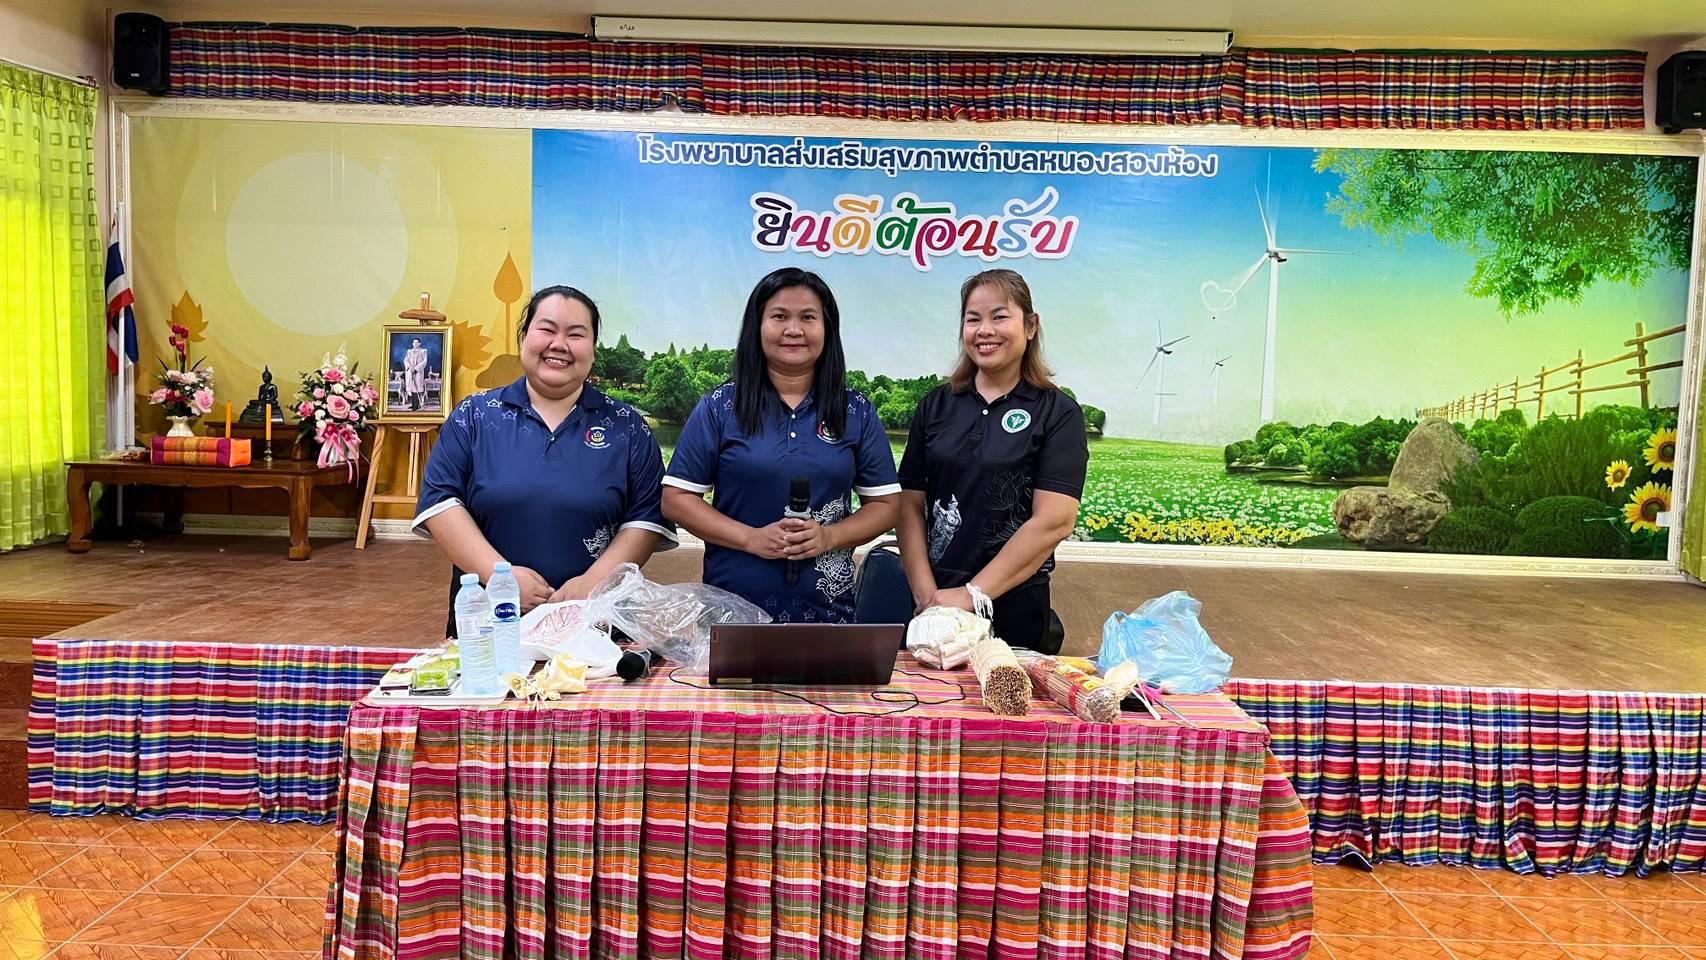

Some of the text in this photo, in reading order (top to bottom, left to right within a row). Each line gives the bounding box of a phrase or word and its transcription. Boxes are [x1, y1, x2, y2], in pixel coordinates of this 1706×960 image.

[637, 135, 1218, 177] โรงพยาบาลส่งเสริมสุขภาพตำบลหนองสองห้อง
[754, 192, 1074, 267] ยินดีต้อนรับ
